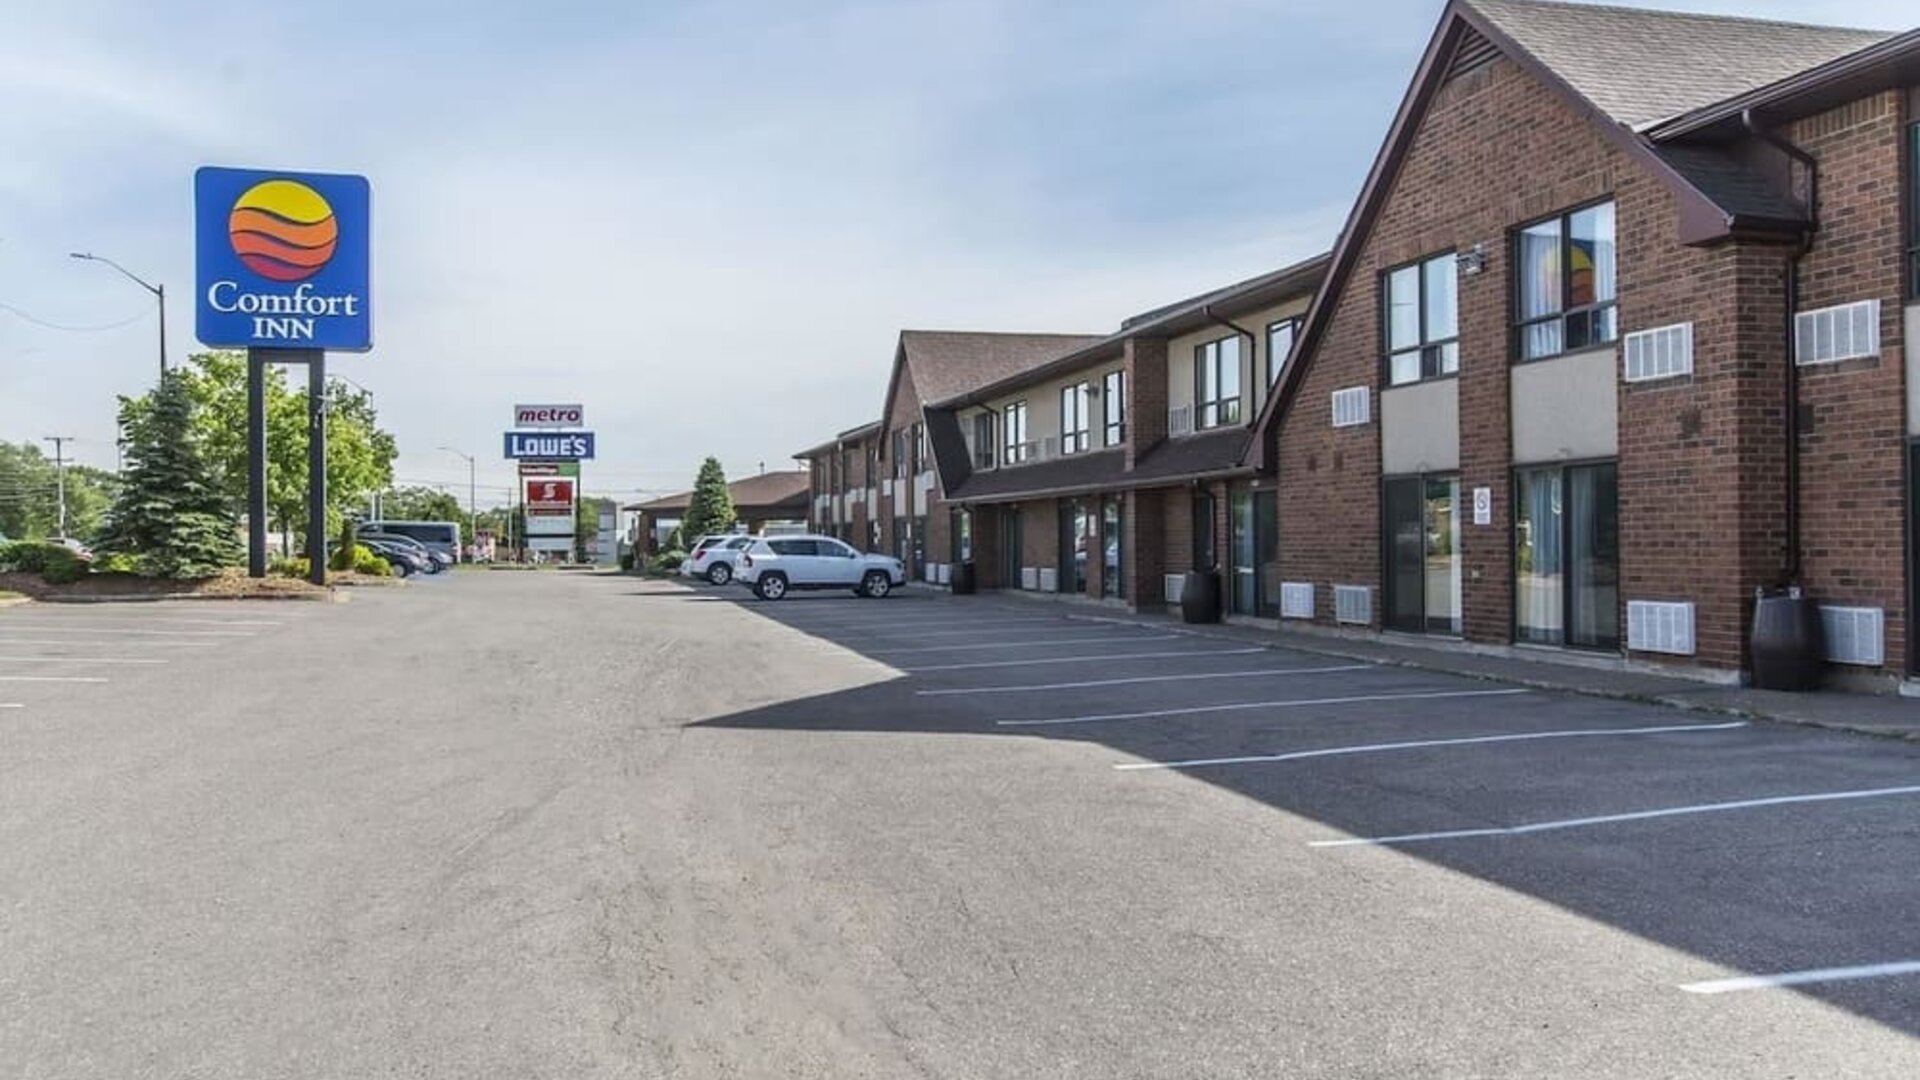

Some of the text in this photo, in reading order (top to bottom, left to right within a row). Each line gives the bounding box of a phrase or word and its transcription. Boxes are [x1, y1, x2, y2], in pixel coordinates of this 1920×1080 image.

[208, 280, 358, 316] Comfort
[252, 316, 315, 339] INN
[520, 408, 579, 421] metro
